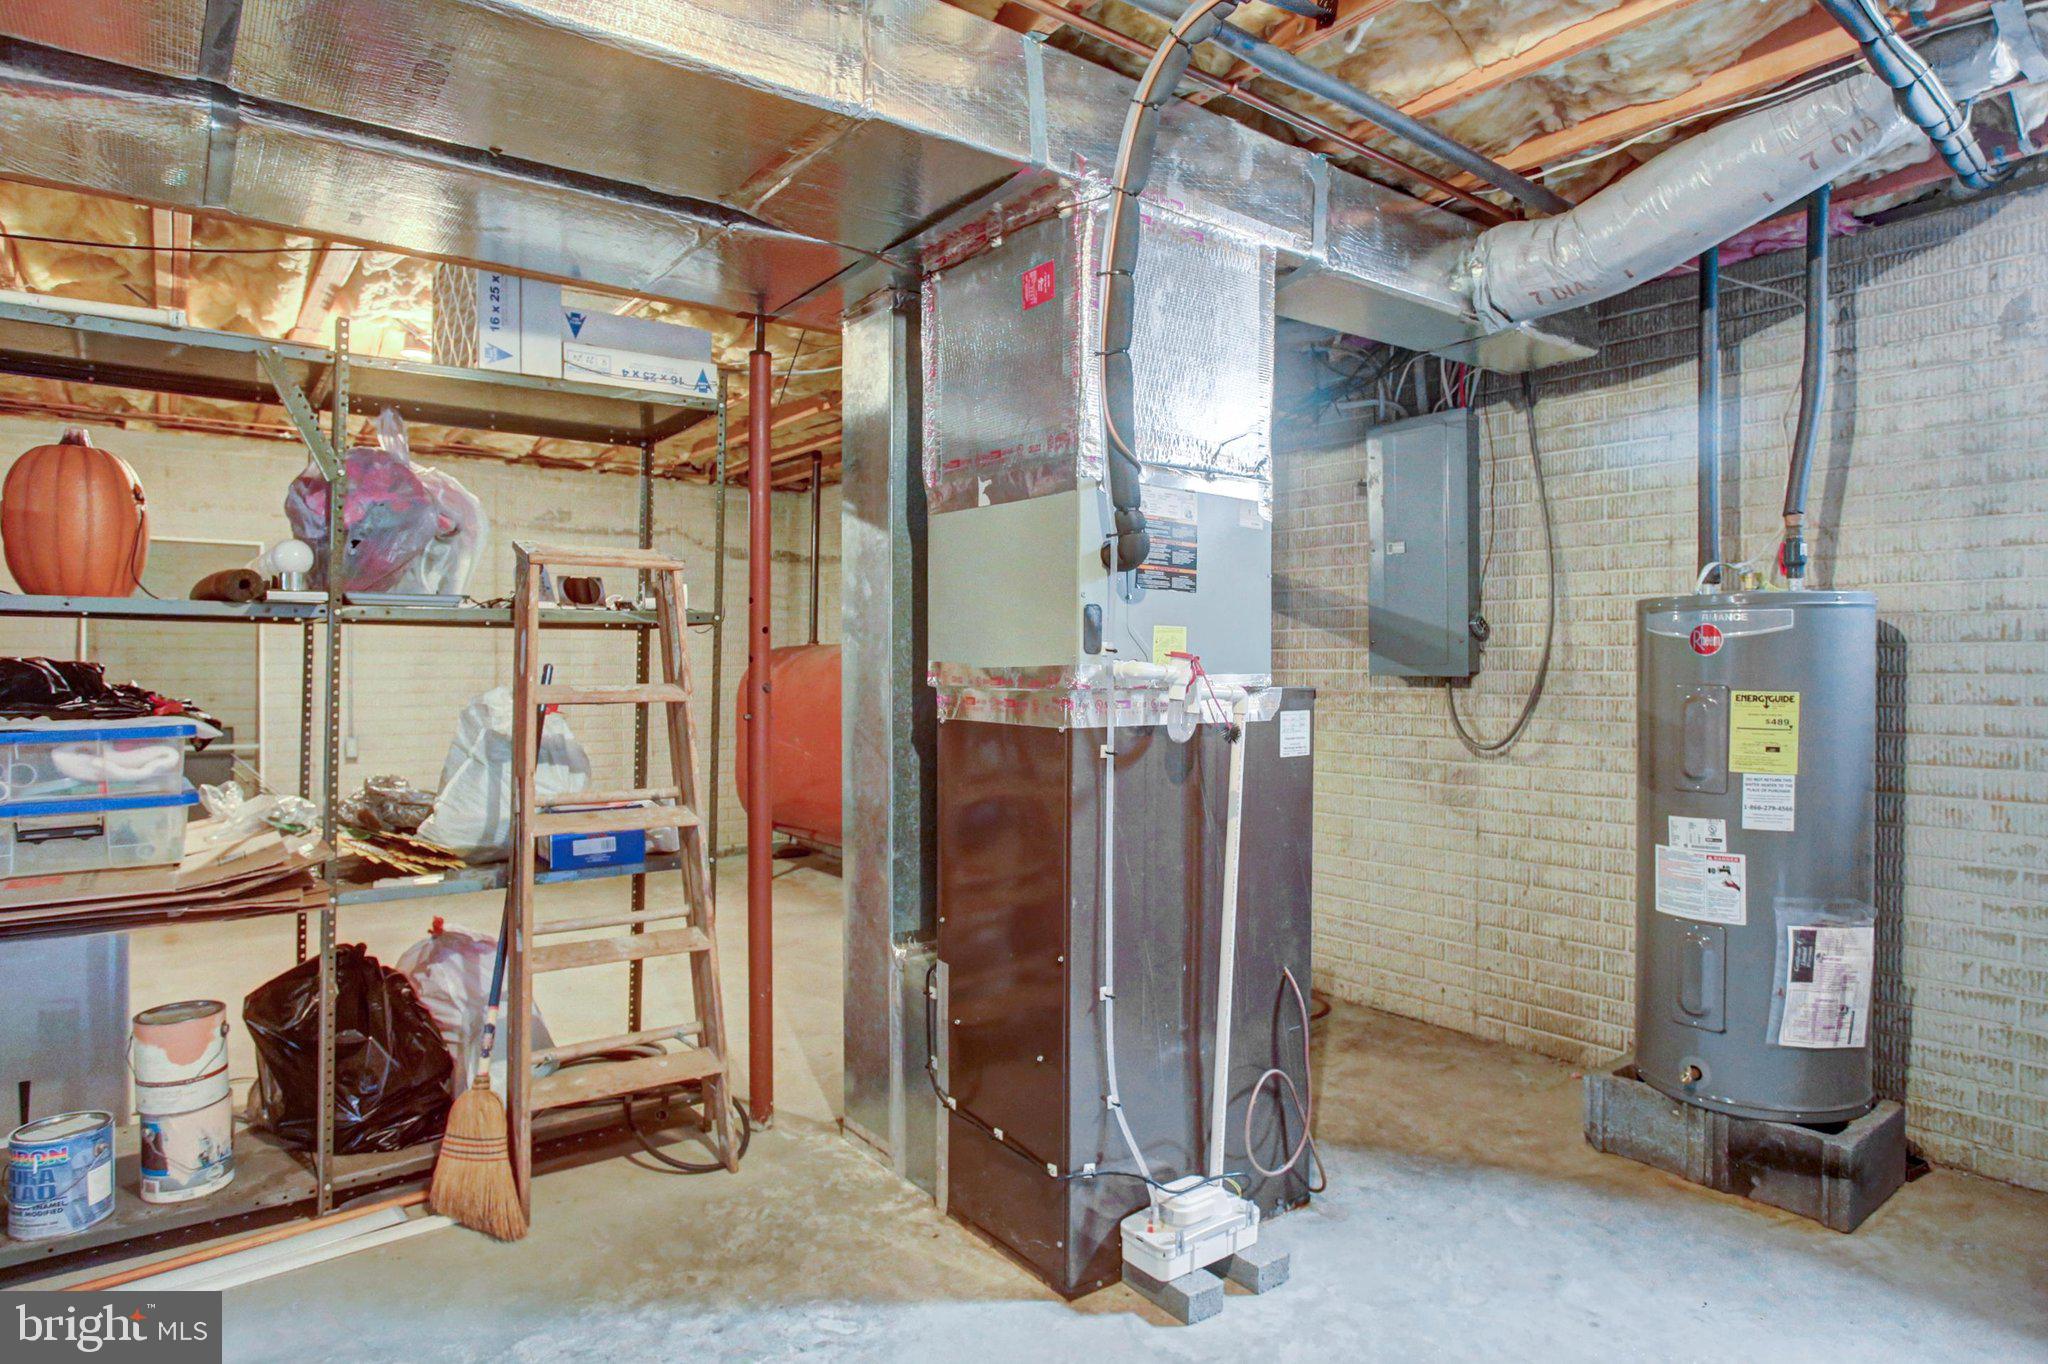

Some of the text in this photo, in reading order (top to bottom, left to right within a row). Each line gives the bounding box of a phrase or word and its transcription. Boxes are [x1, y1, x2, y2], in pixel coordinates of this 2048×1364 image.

[1798, 116, 1881, 171] 7 DIA
[489, 286, 501, 302] 25
[1528, 290, 1544, 306] 7
[489, 316, 501, 332] 16
[622, 368, 630, 377] 4
[643, 371, 657, 382] 25
[1765, 718, 1790, 726] $489
[24, 1208, 64, 1217] MODIFIED
